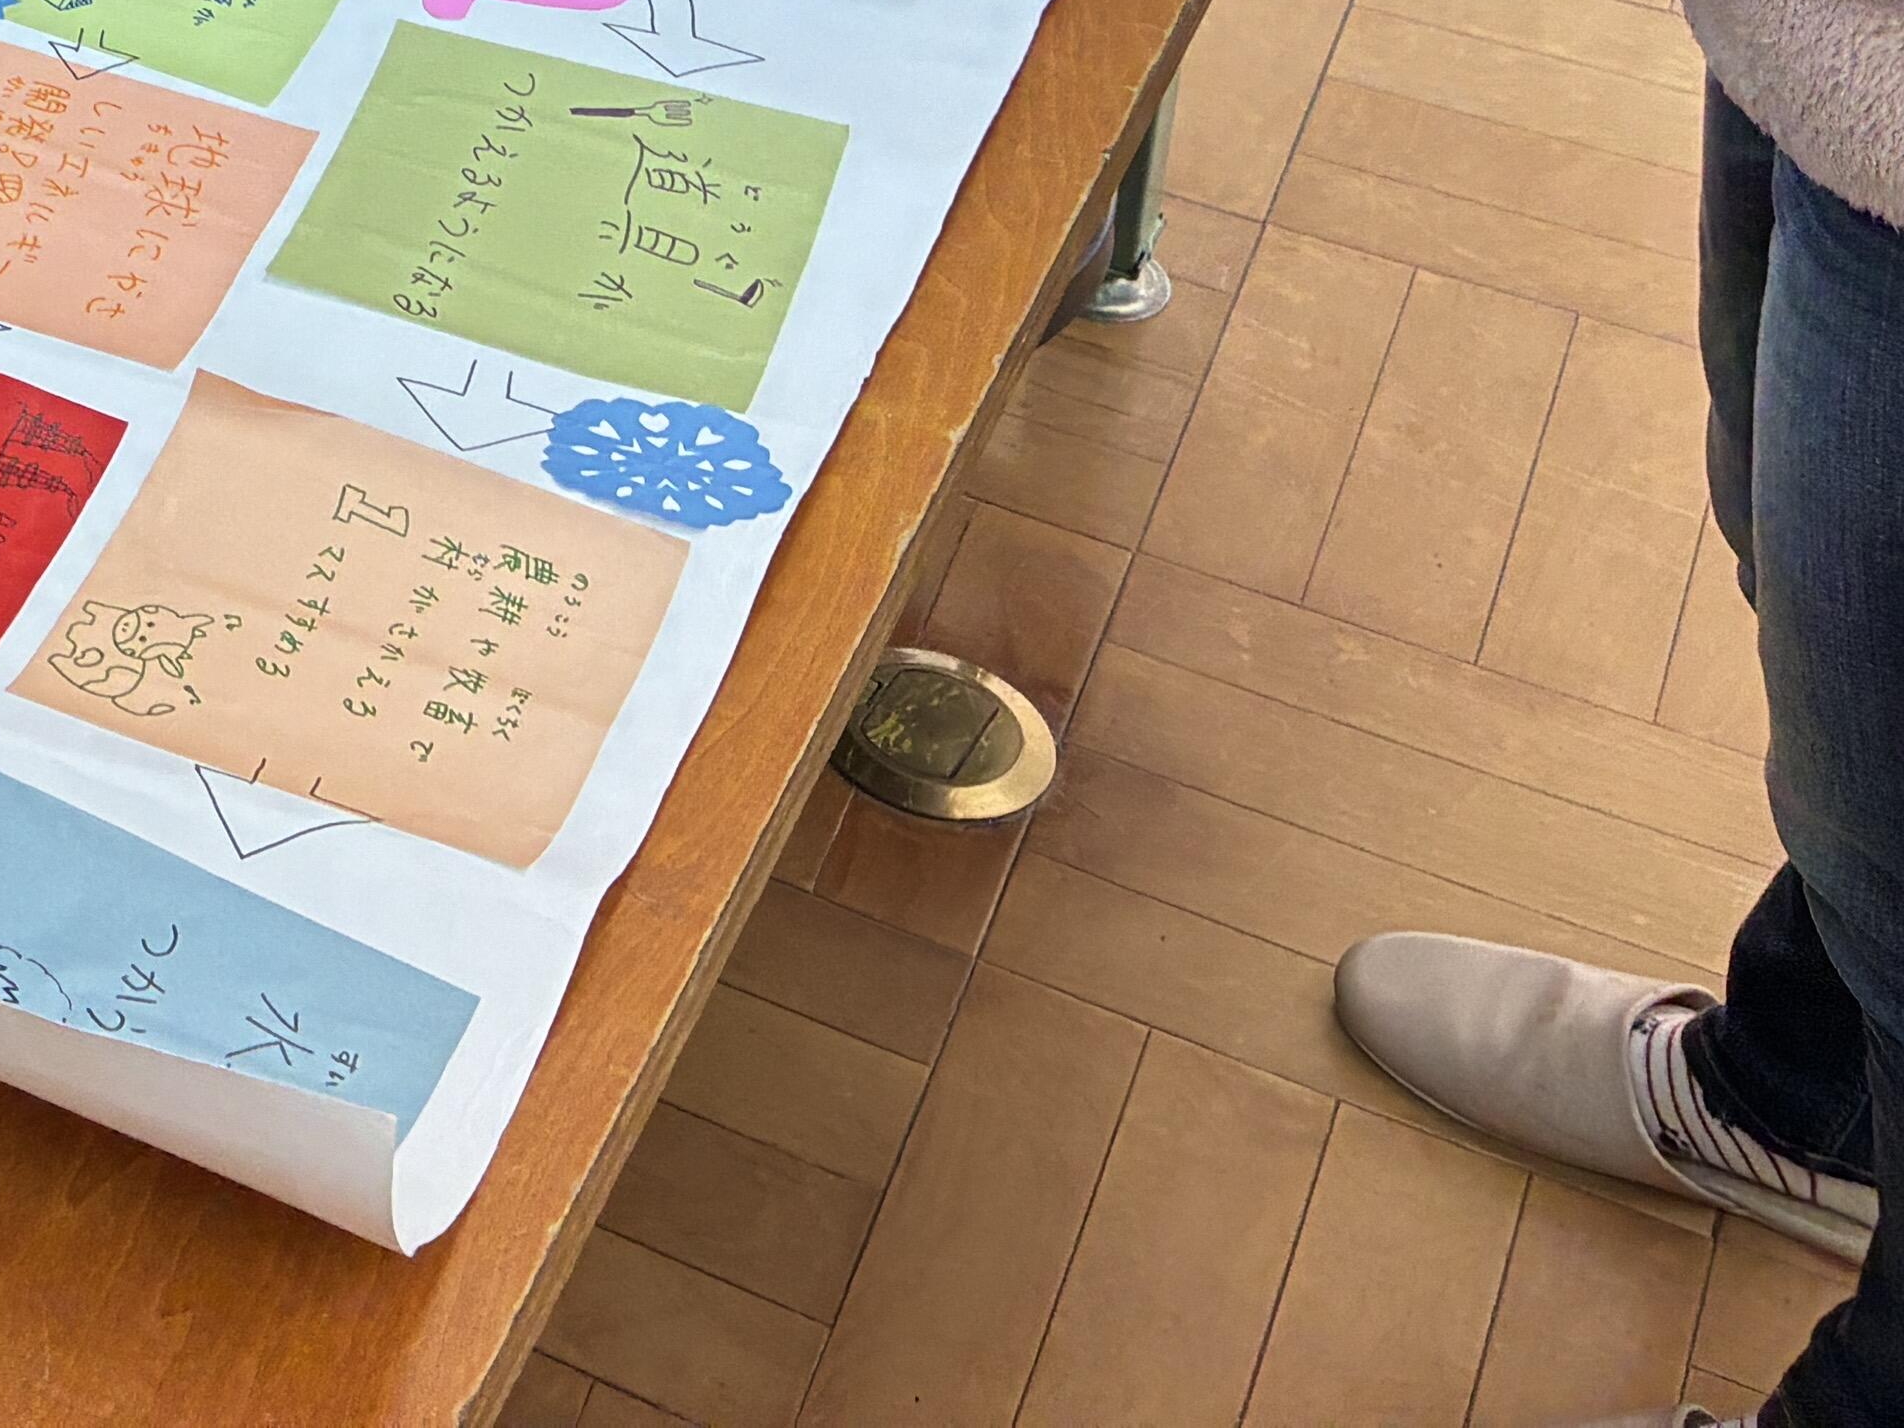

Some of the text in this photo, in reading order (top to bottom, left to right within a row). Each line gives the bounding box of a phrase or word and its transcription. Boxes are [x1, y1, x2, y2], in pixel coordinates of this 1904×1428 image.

[82, 124, 239, 323] 地球にやさ
[376, 67, 565, 323] つかえるようになる
[544, 133, 745, 330] 道具が
[242, 482, 420, 695] 1マスすすめる
[337, 531, 474, 725] 村がさかえる
[391, 543, 566, 776] 農耕や牧畜で
